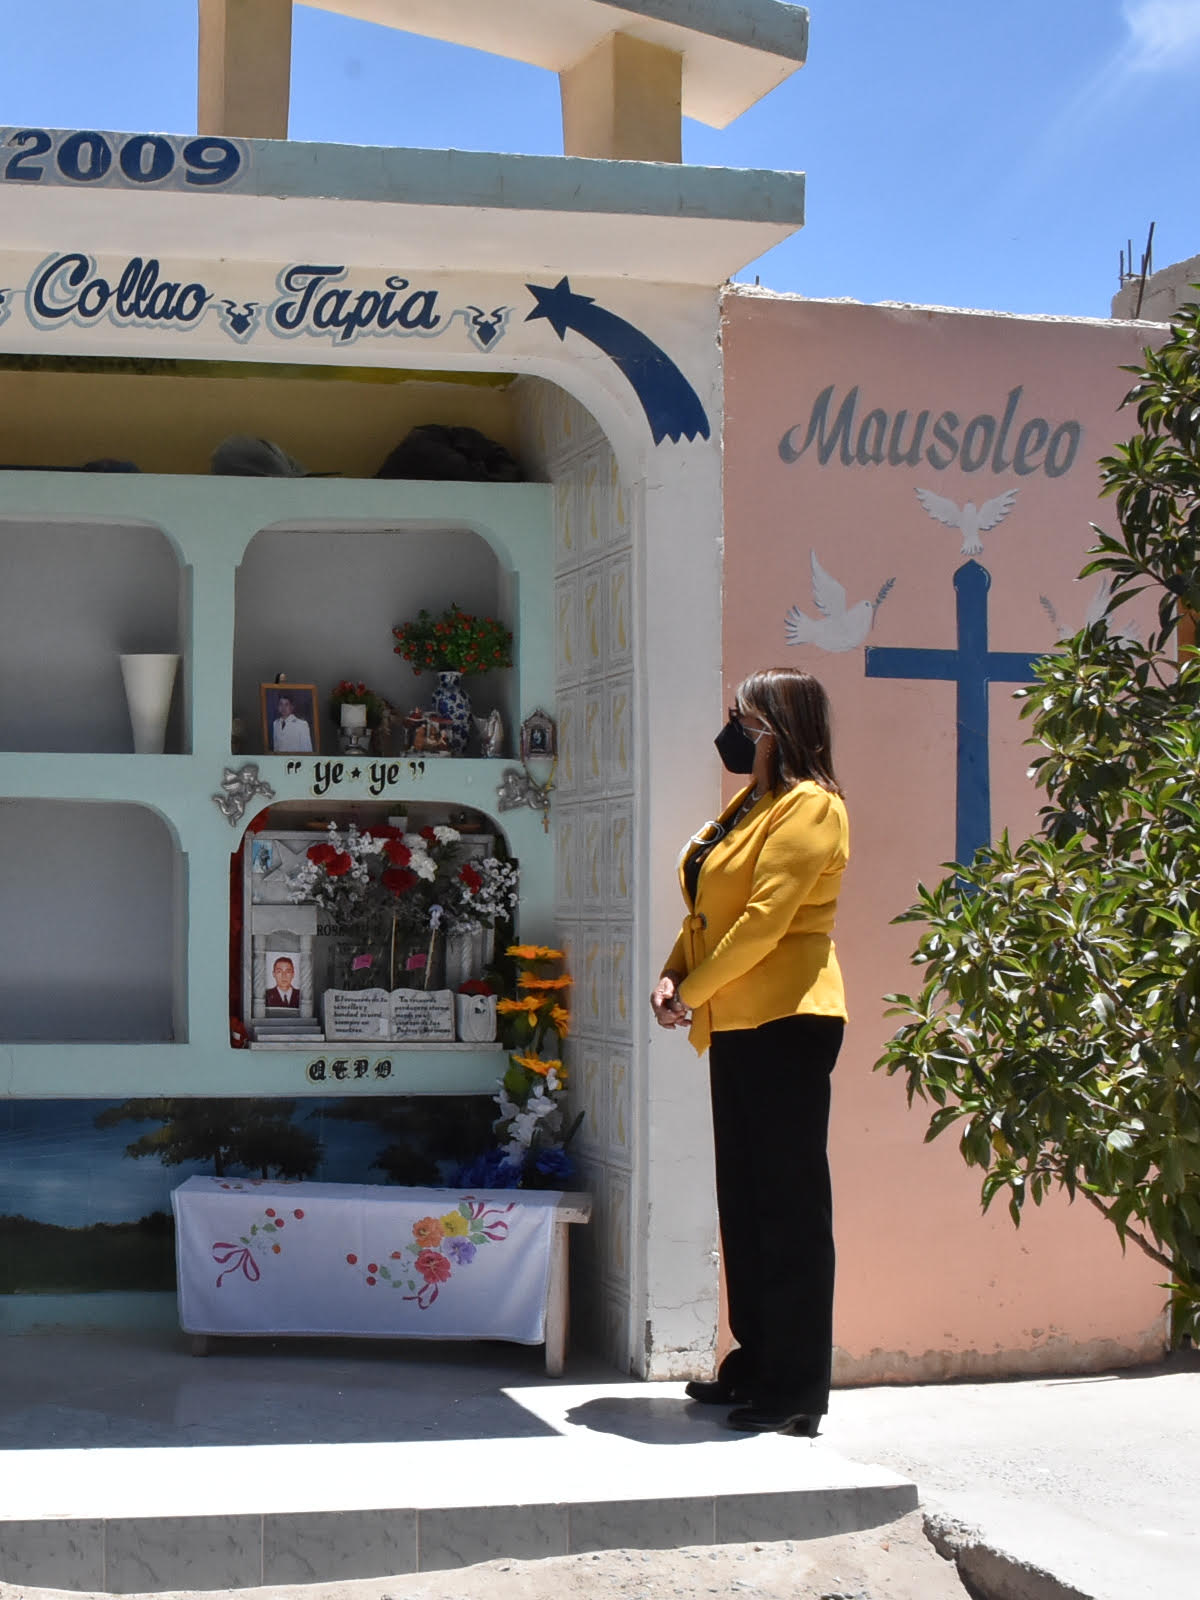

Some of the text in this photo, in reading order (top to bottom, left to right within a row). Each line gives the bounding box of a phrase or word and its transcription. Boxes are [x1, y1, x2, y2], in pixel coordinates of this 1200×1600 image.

[4, 128, 242, 185] 2009
[33, 252, 215, 321] Collao
[275, 264, 441, 341] Tapia
[777, 384, 1082, 478] Mausoleo
